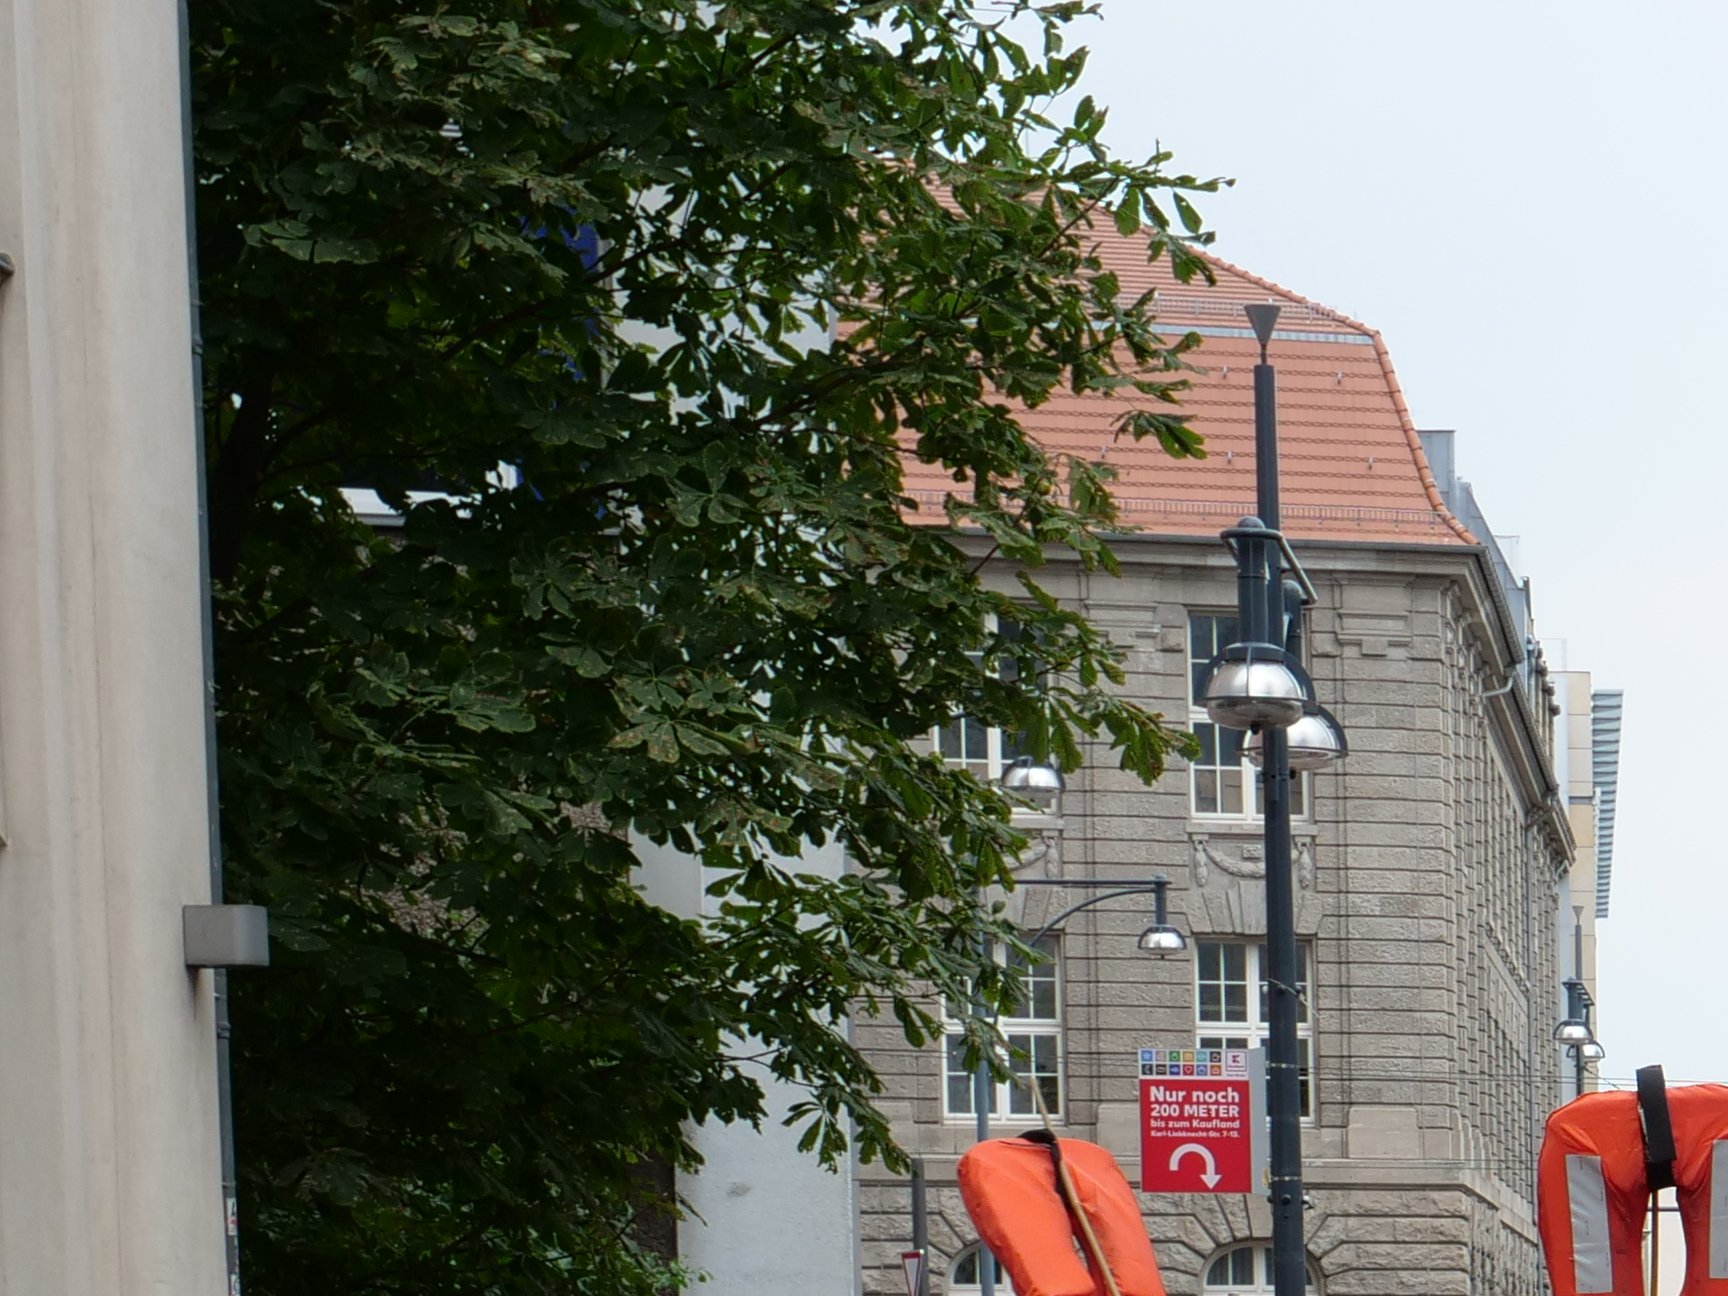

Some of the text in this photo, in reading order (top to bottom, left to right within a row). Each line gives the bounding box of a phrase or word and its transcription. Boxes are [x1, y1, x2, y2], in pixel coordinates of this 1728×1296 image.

[1149, 1086, 1240, 1103] Nur noch
[1150, 1104, 1240, 1117] 200 METER
[1150, 1119, 1240, 1129] bis zum Kaufland
